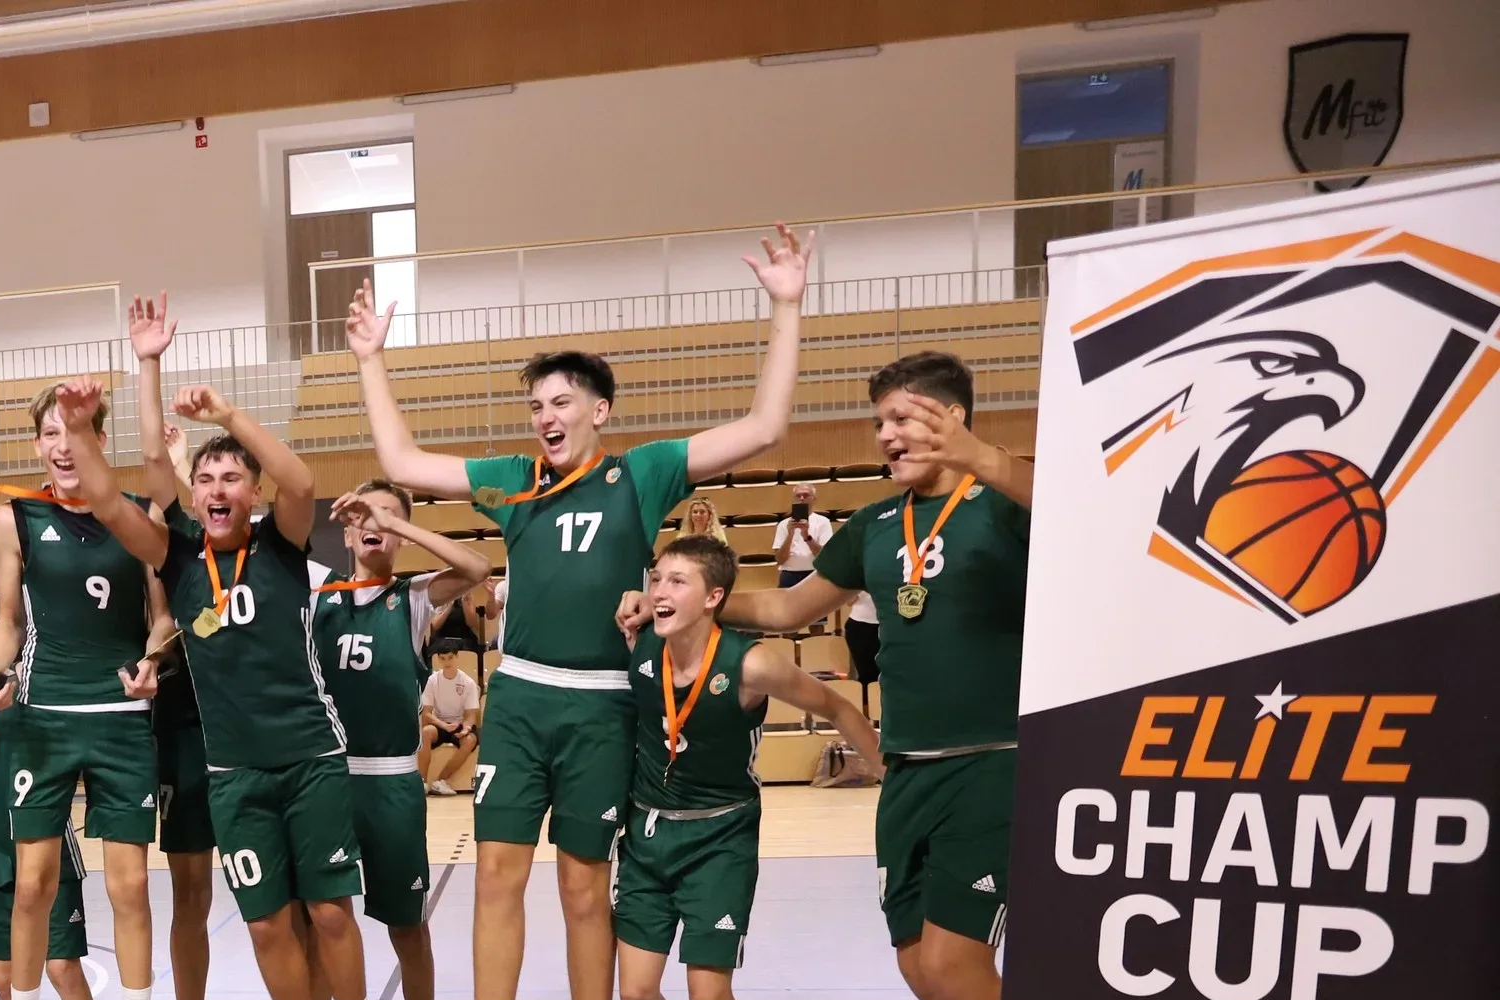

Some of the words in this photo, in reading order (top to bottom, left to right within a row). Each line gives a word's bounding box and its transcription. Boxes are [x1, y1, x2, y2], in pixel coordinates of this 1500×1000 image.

[555, 511, 603, 553] 17
[896, 535, 945, 583] 18
[85, 575, 111, 610] 9
[336, 633, 373, 671] 15
[13, 769, 34, 807] 9
[1054, 788, 1490, 895] CHAMP
[222, 848, 263, 889] 10
